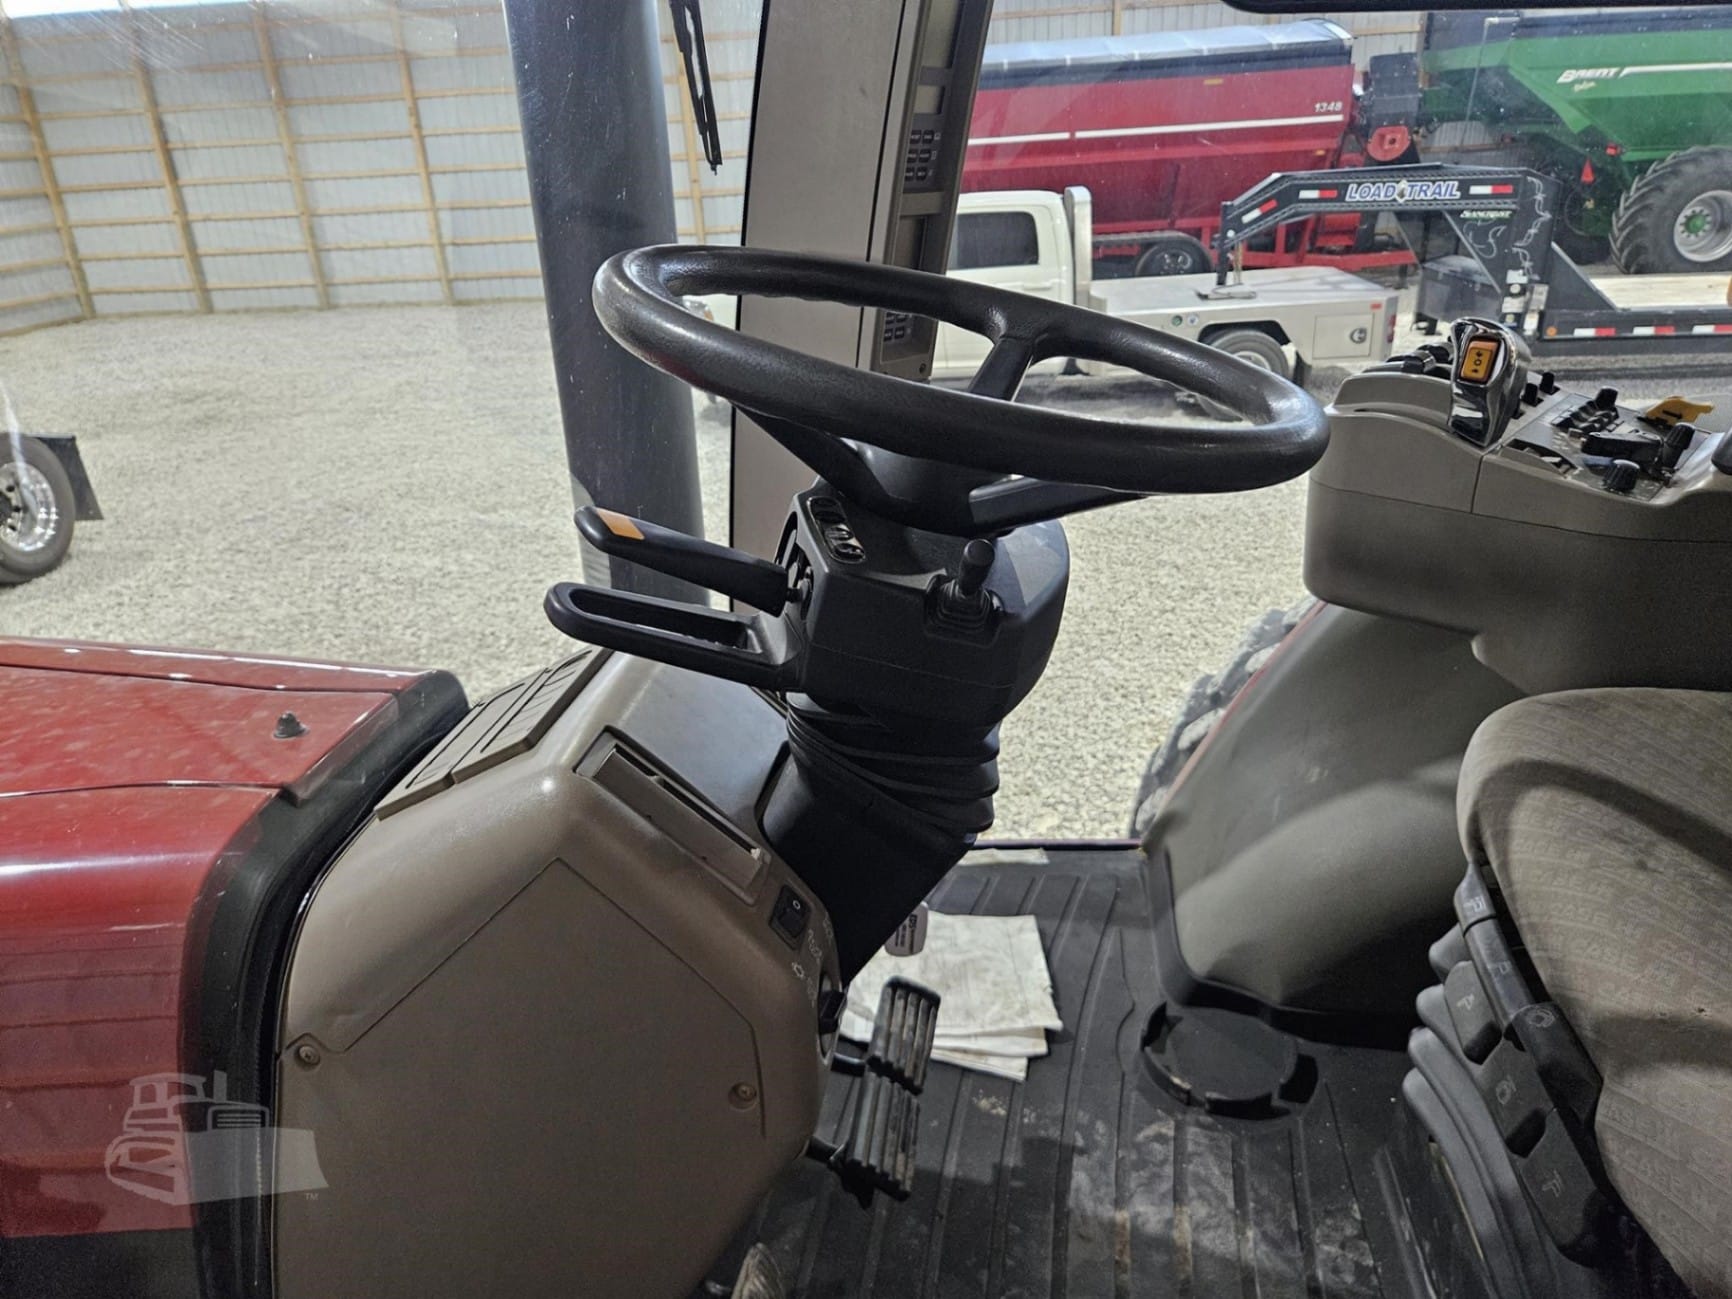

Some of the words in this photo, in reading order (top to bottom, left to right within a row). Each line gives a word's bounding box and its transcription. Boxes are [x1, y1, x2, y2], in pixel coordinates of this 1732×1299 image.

[1314, 101, 1343, 112] 1348
[1346, 181, 1398, 201] LOAD
[1405, 181, 1461, 200] TRAIL
